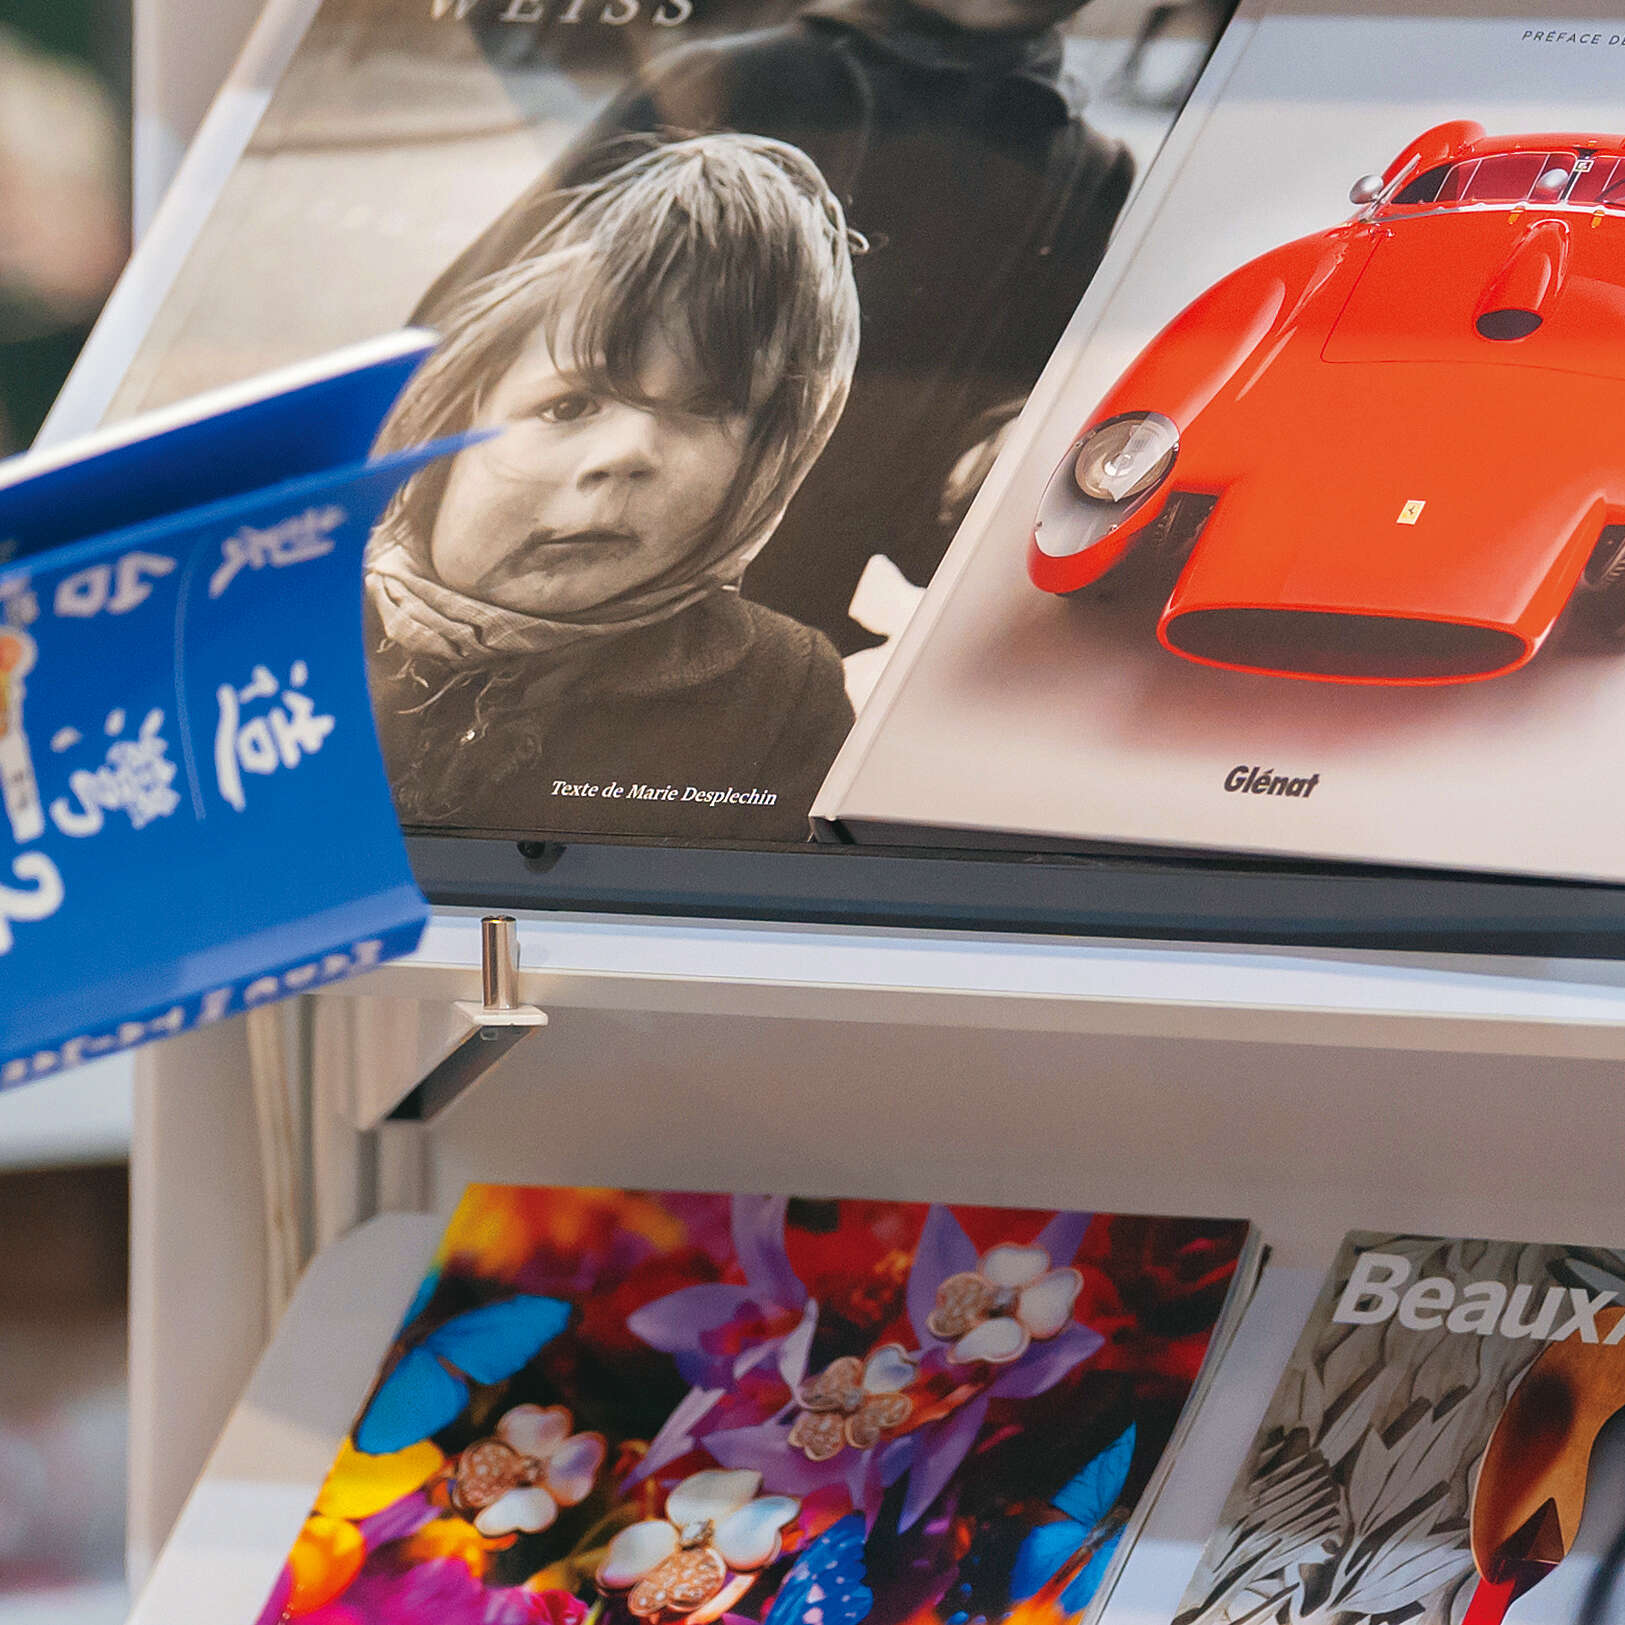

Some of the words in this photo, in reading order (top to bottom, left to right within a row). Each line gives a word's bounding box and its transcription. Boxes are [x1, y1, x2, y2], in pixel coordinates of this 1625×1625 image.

[1521, 27, 1604, 47] PRÉFACE
[550, 780, 599, 798] Texte
[601, 781, 625, 800] de
[625, 783, 679, 802] Marie
[679, 785, 778, 807] Desplechin
[1223, 764, 1321, 798] Glénat
